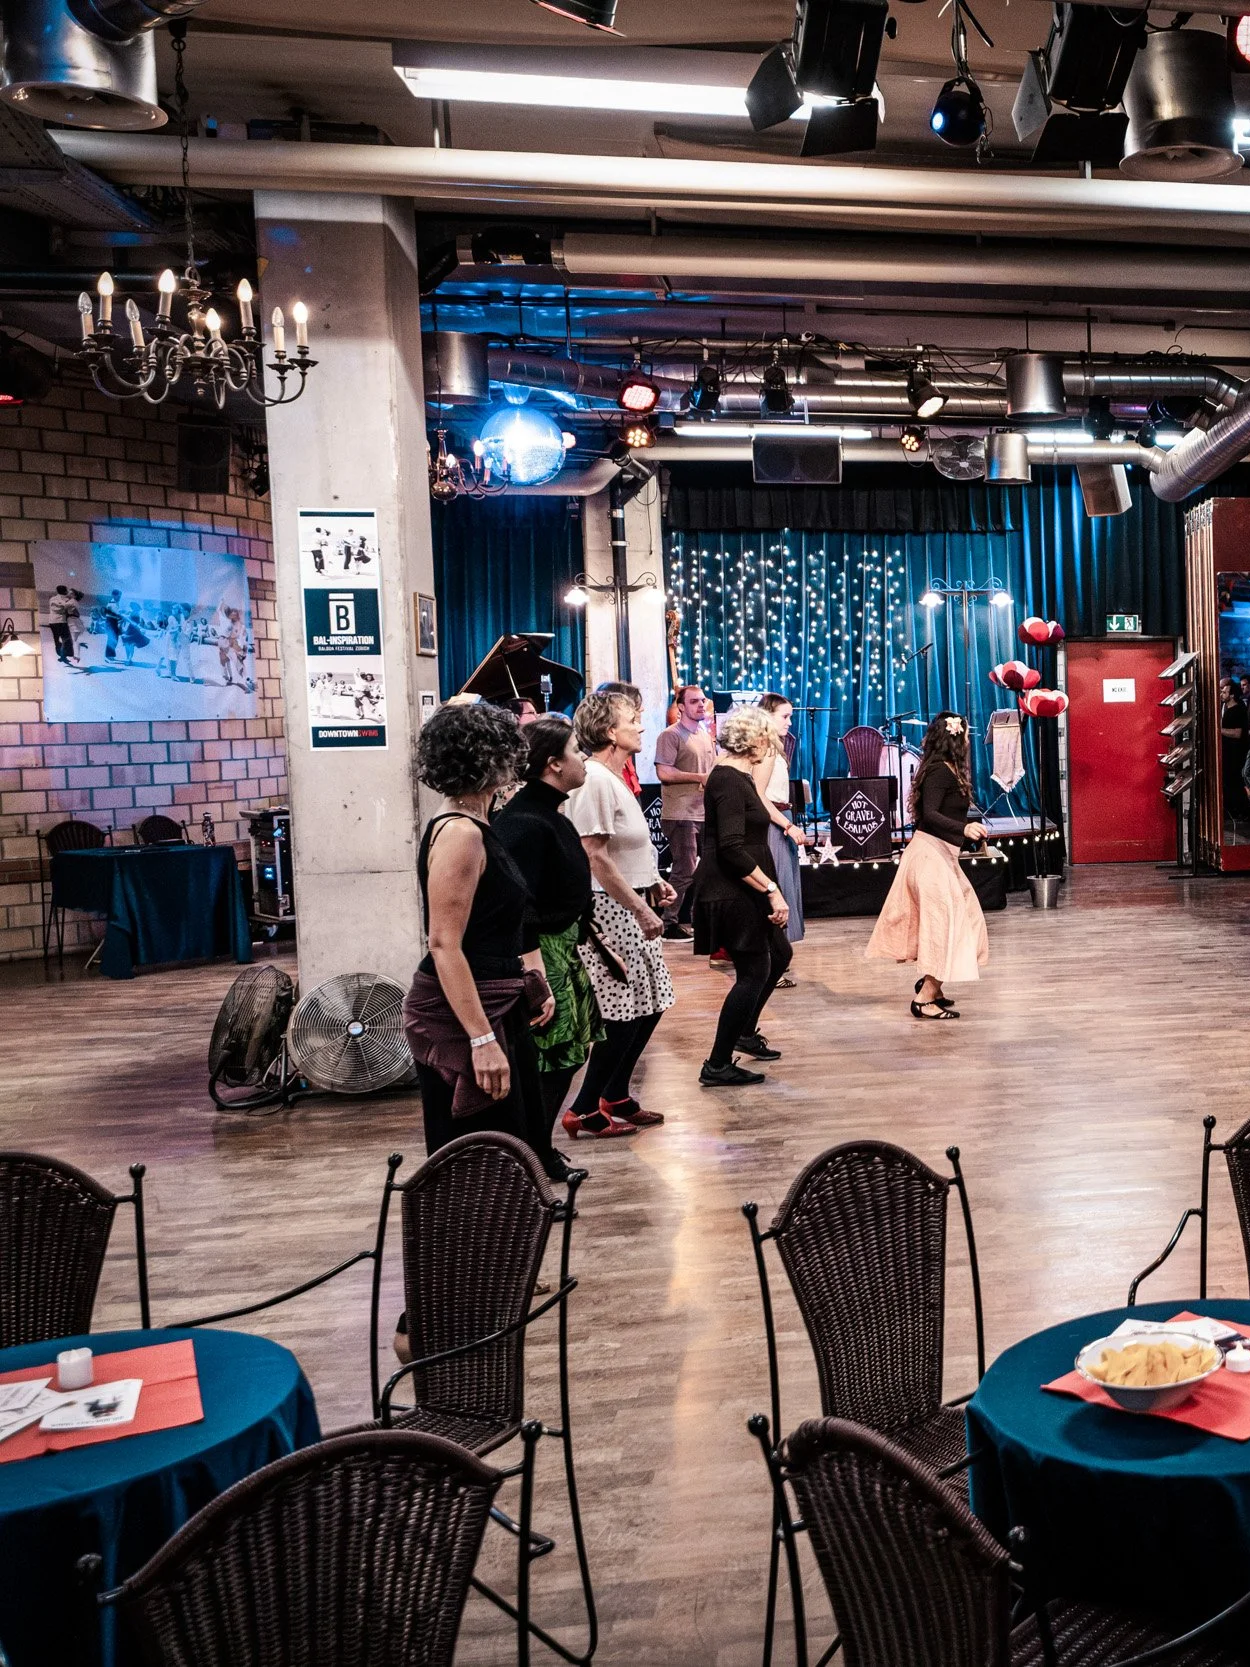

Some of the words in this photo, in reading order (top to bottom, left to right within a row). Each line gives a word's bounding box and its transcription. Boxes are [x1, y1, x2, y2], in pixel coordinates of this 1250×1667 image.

[335, 604, 350, 631] B
[313, 635, 374, 645] BAL-INSPIRATION
[851, 800, 869, 810] HOT
[650, 807, 661, 816] HO
[845, 810, 875, 822] GRAVEL
[843, 821, 878, 833] ESKIMOS
